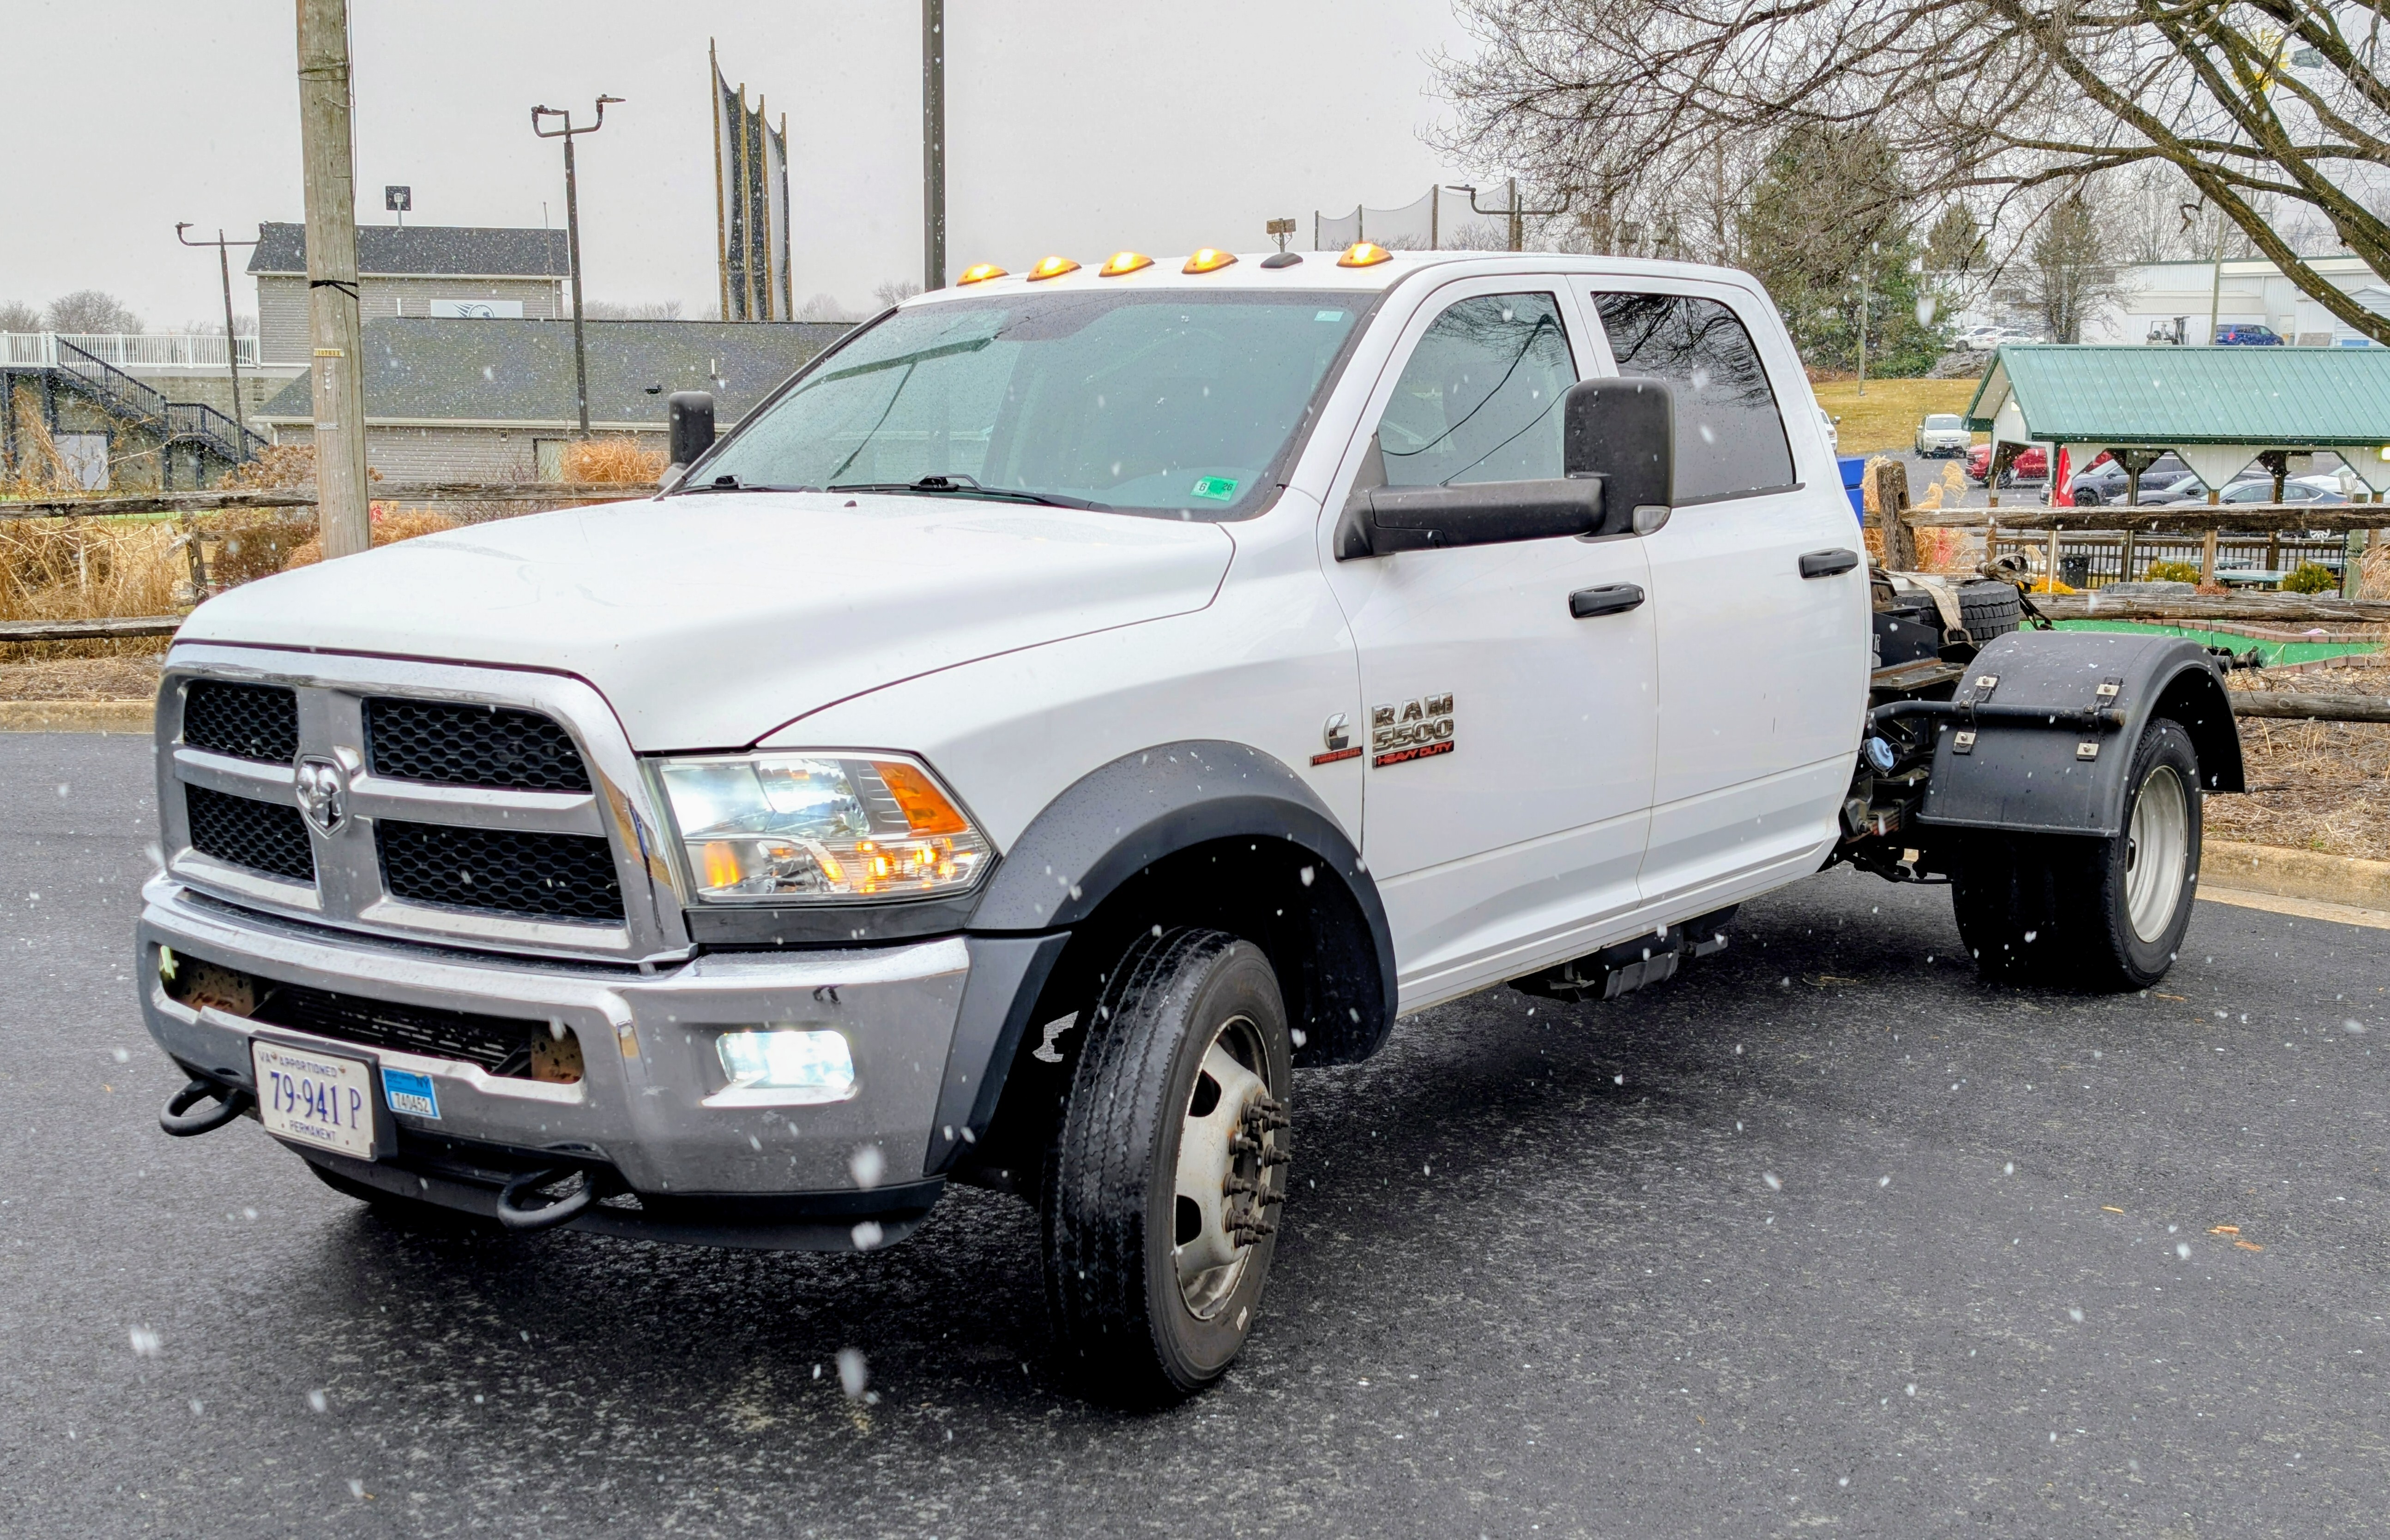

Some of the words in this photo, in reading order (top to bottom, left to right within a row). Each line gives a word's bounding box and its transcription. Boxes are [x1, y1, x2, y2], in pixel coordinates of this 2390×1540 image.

[1199, 482, 1207, 491] 6
[1222, 482, 1233, 491] 26
[1371, 692, 1454, 728] RAM
[1372, 716, 1454, 753] 5500
[1378, 749, 1418, 765] HEAVY
[1419, 742, 1453, 757] DUTY
[259, 1050, 272, 1063] VA
[279, 1054, 338, 1078] APPORTIONED
[270, 1069, 341, 1125] 79-941
[348, 1086, 363, 1130] P
[289, 1119, 336, 1142] PERMANENT
